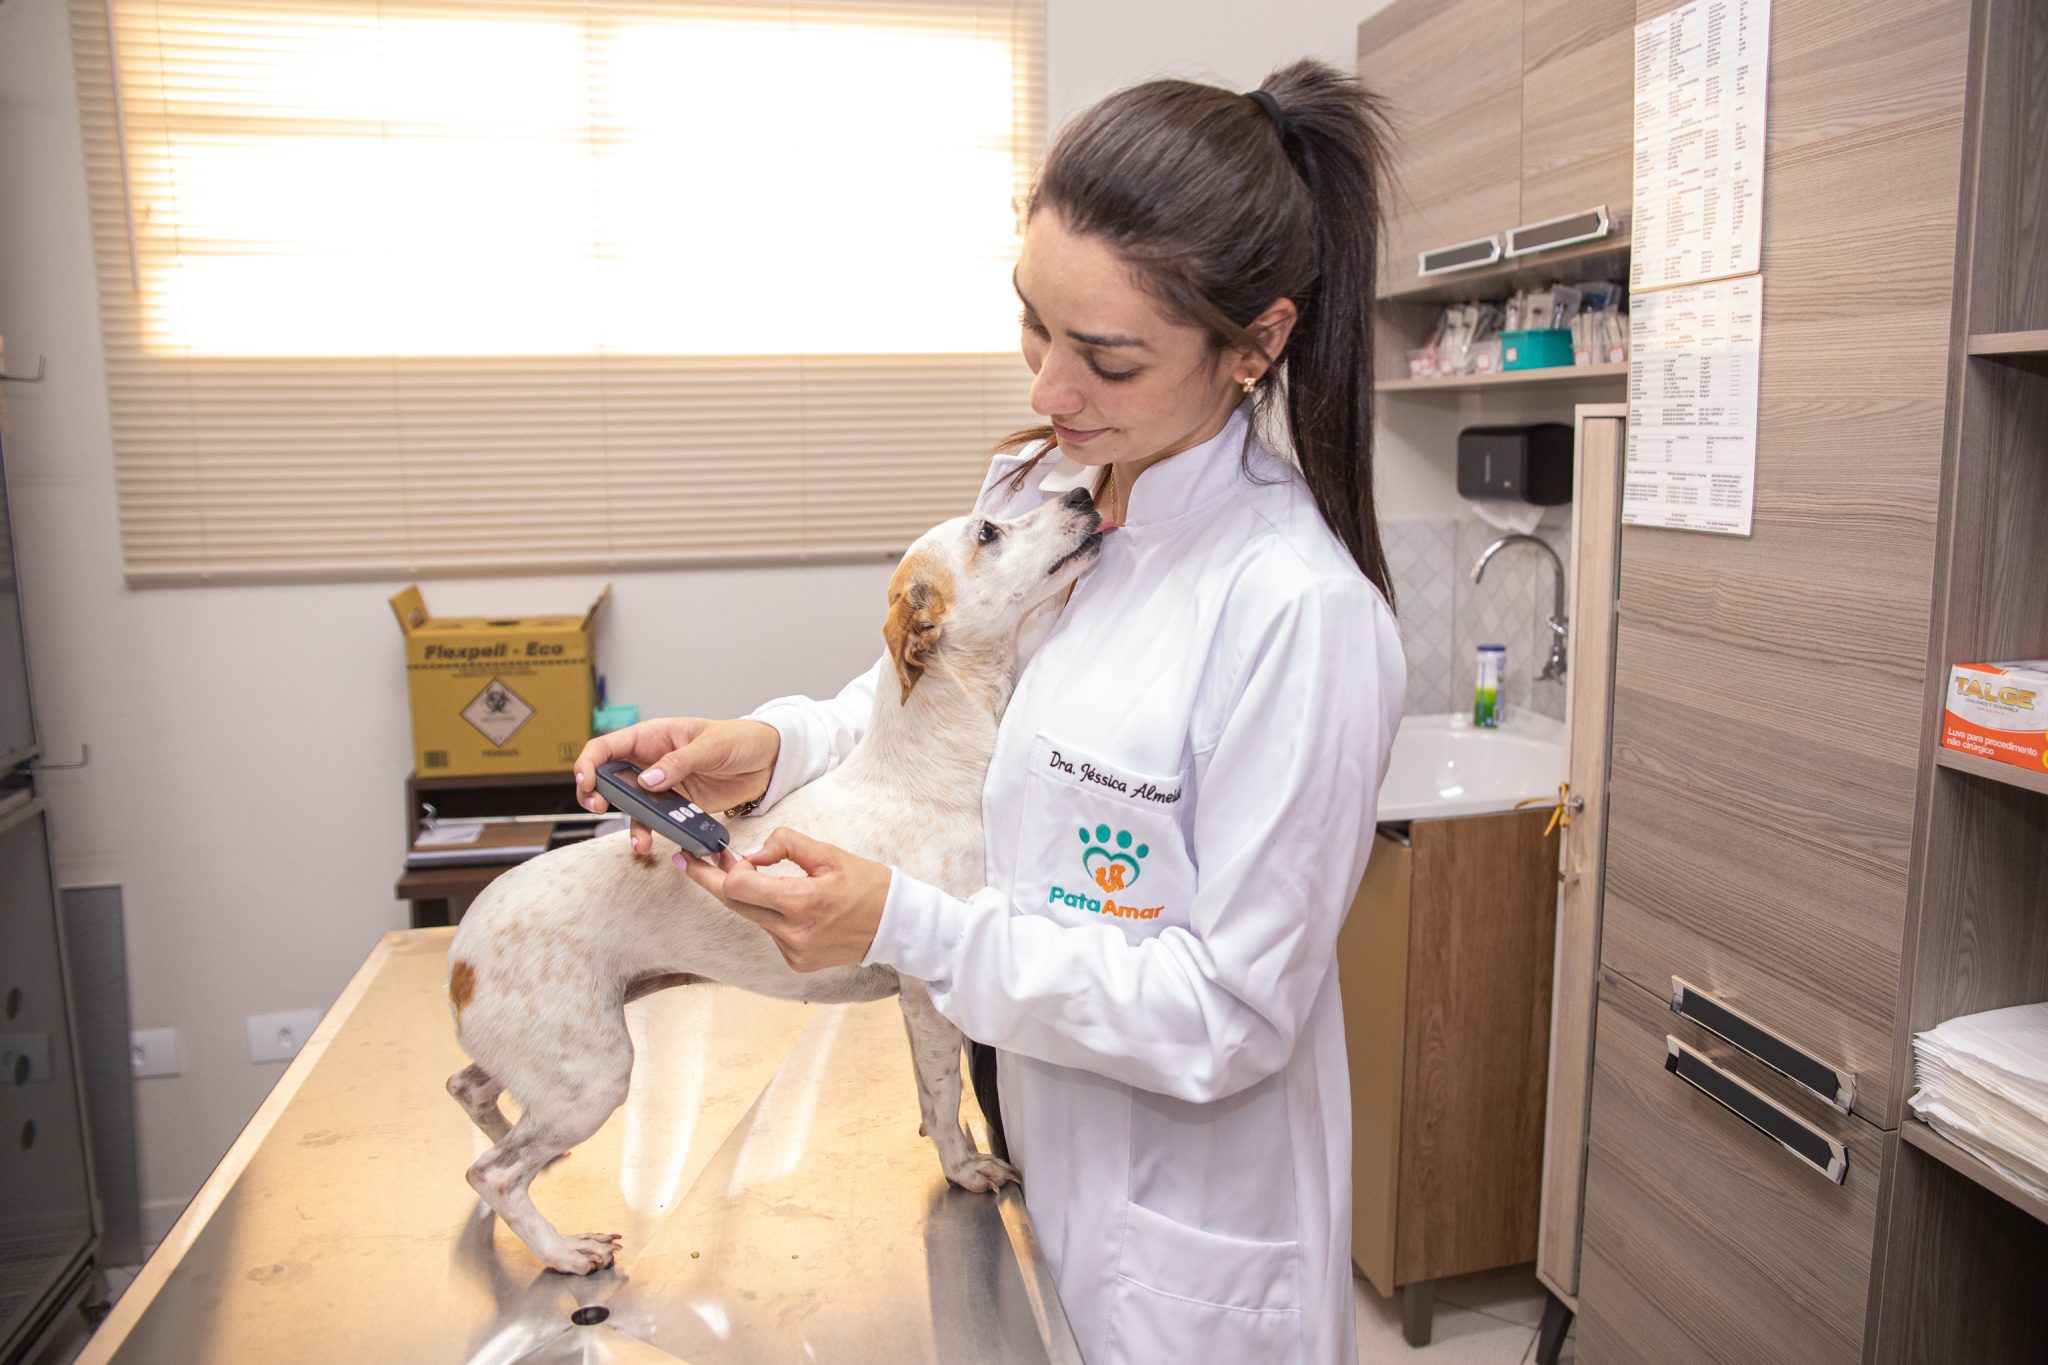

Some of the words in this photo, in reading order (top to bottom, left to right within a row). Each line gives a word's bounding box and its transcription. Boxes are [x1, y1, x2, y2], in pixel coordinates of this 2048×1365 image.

[526, 641, 563, 656] Eco
[1955, 676, 2037, 711] TALGE
[1947, 737, 1961, 747] não
[1962, 740, 1994, 755] cirúrgico
[1948, 727, 1966, 739] Luva
[1967, 733, 1984, 743] para
[1985, 737, 2038, 757] procedimento
[1049, 751, 1076, 775] Dra.
[1080, 763, 1127, 793] Jéssica
[1130, 783, 1182, 804] Almei
